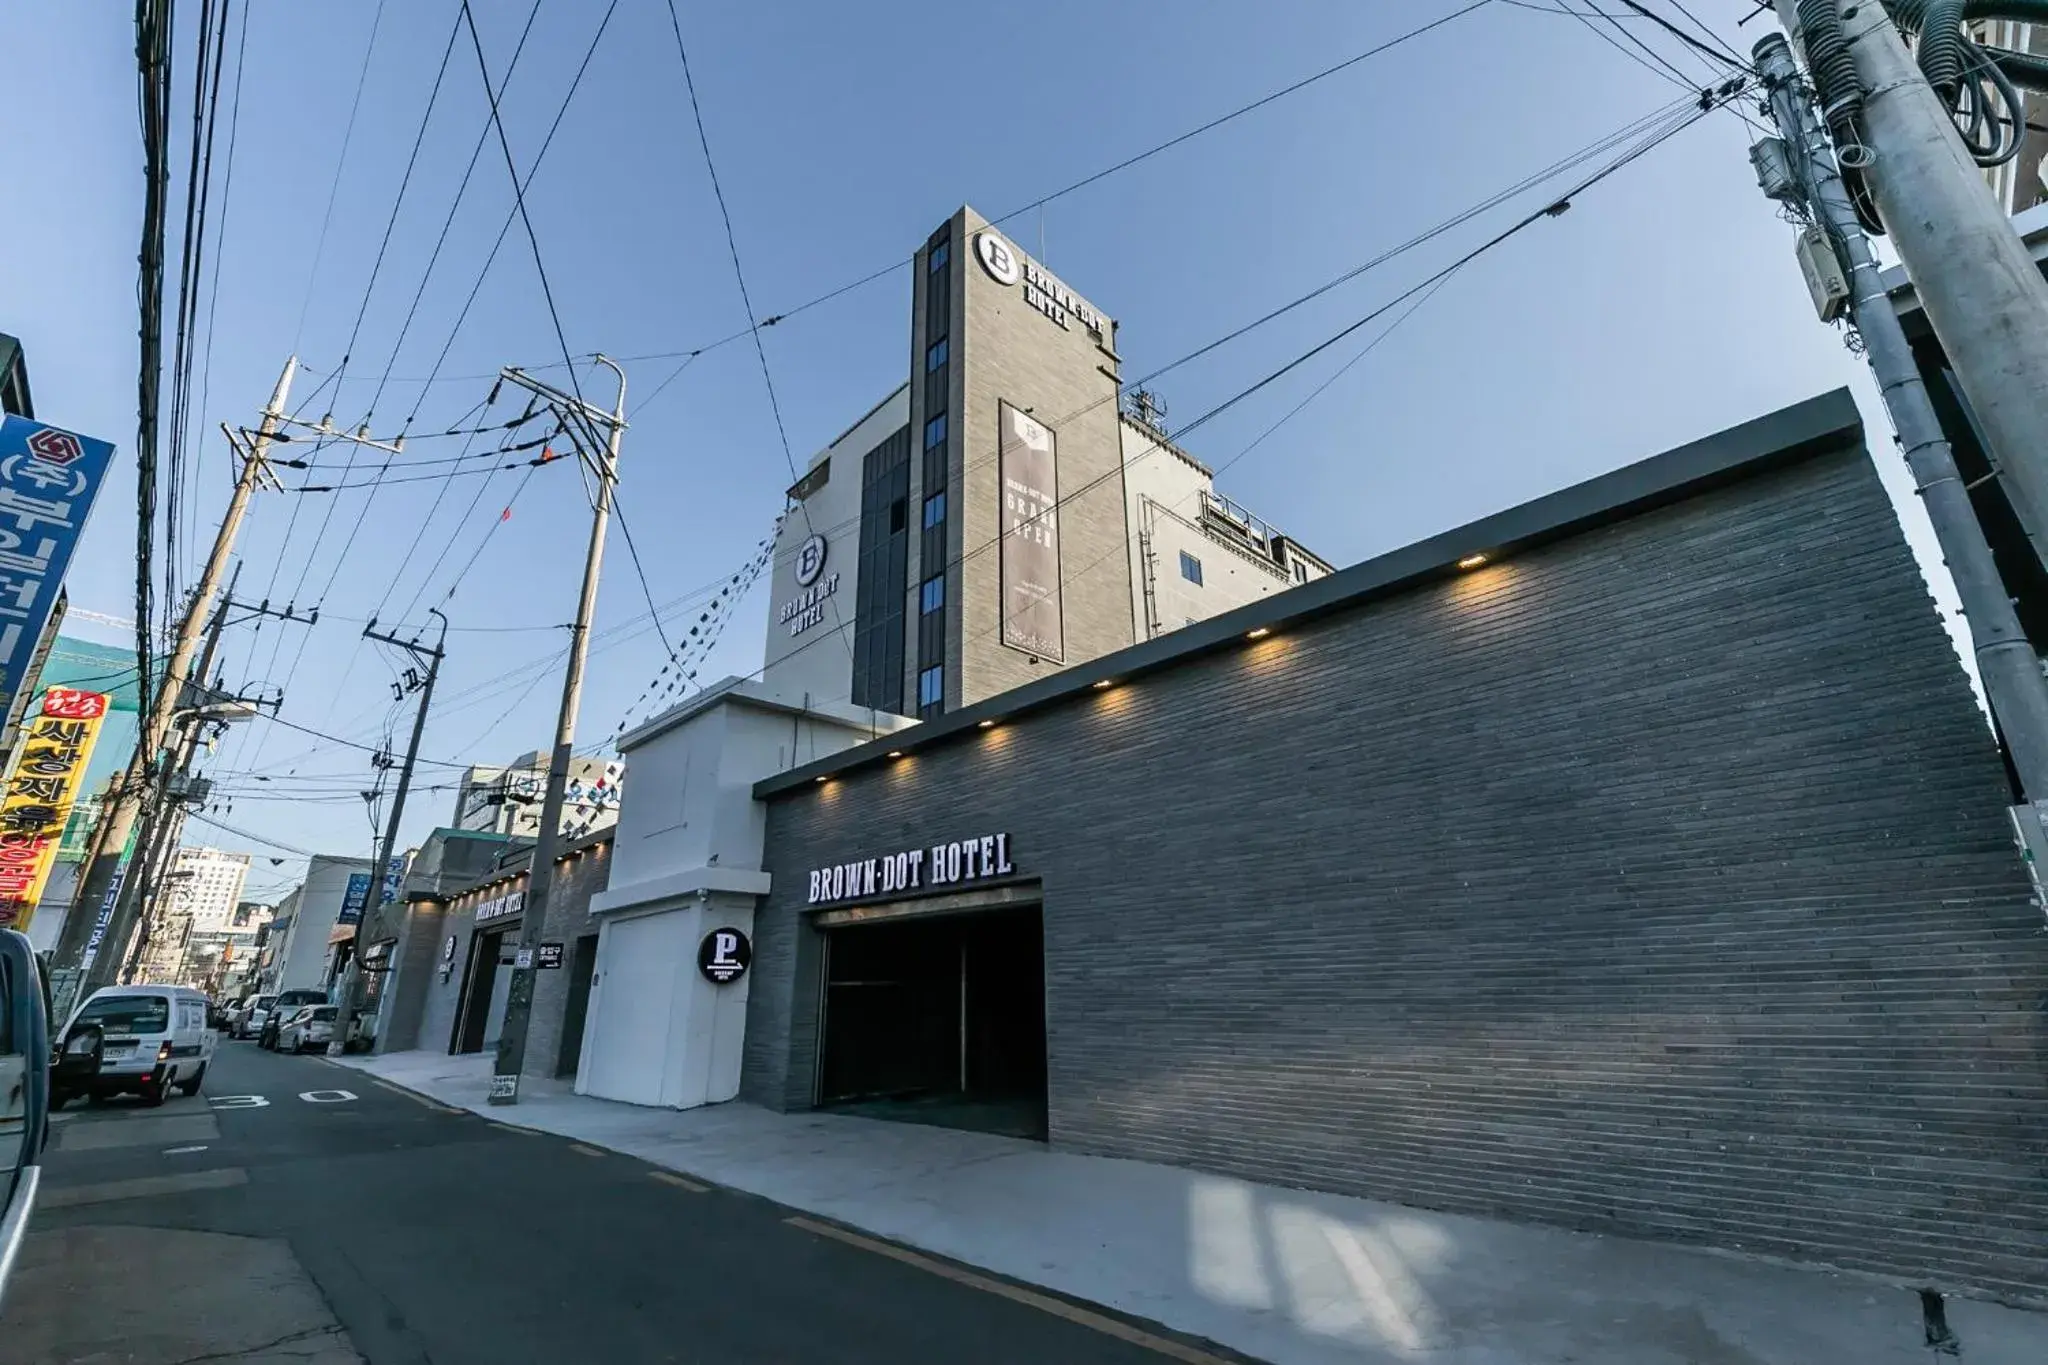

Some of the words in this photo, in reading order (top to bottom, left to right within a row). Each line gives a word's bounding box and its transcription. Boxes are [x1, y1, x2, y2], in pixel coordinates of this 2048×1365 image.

[1024, 283, 1070, 331] HOTEL
[1014, 518, 1051, 549] OPEN
[790, 602, 823, 636] HOTEL
[46, 691, 101, 716] 원조
[931, 833, 1012, 884] HOTEL
[714, 933, 737, 964] P
